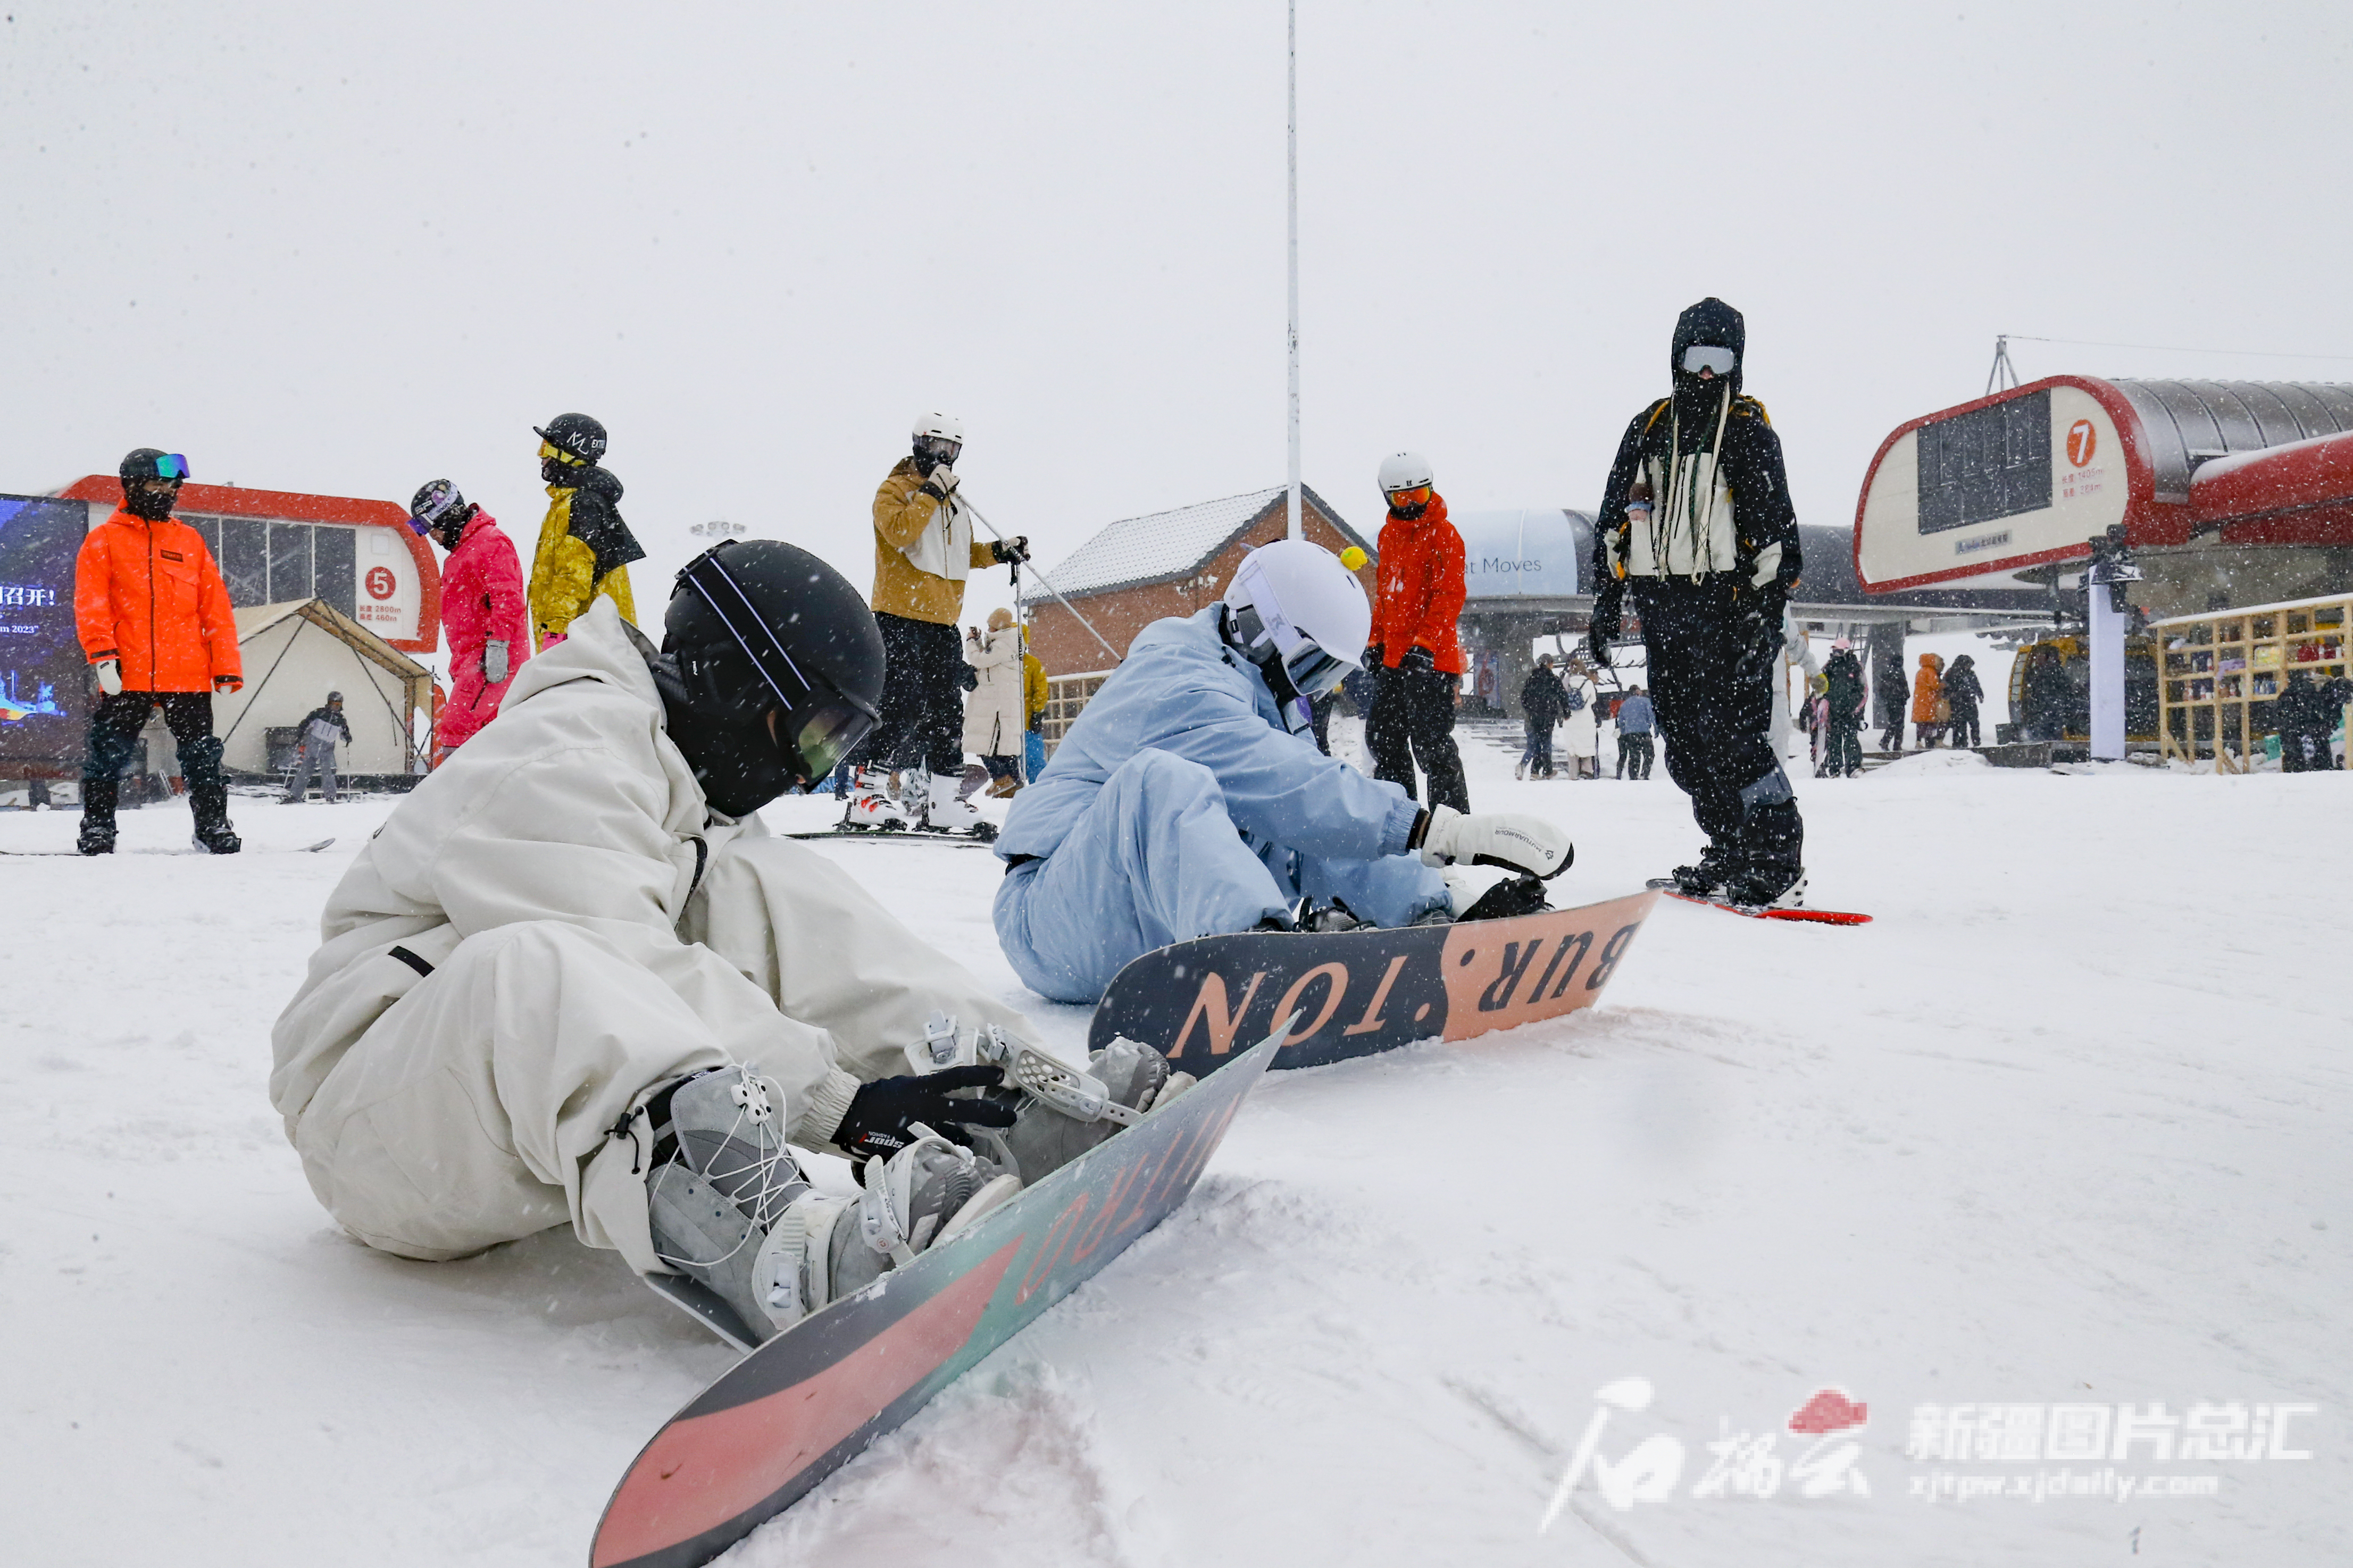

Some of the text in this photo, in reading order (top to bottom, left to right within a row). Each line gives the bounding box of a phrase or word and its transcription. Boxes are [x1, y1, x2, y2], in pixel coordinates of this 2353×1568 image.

[2073, 424, 2089, 464] 7
[1483, 557, 1541, 573] Moves
[373, 572, 389, 594] 5
[1495, 829, 1542, 852] MUTUARMOUR
